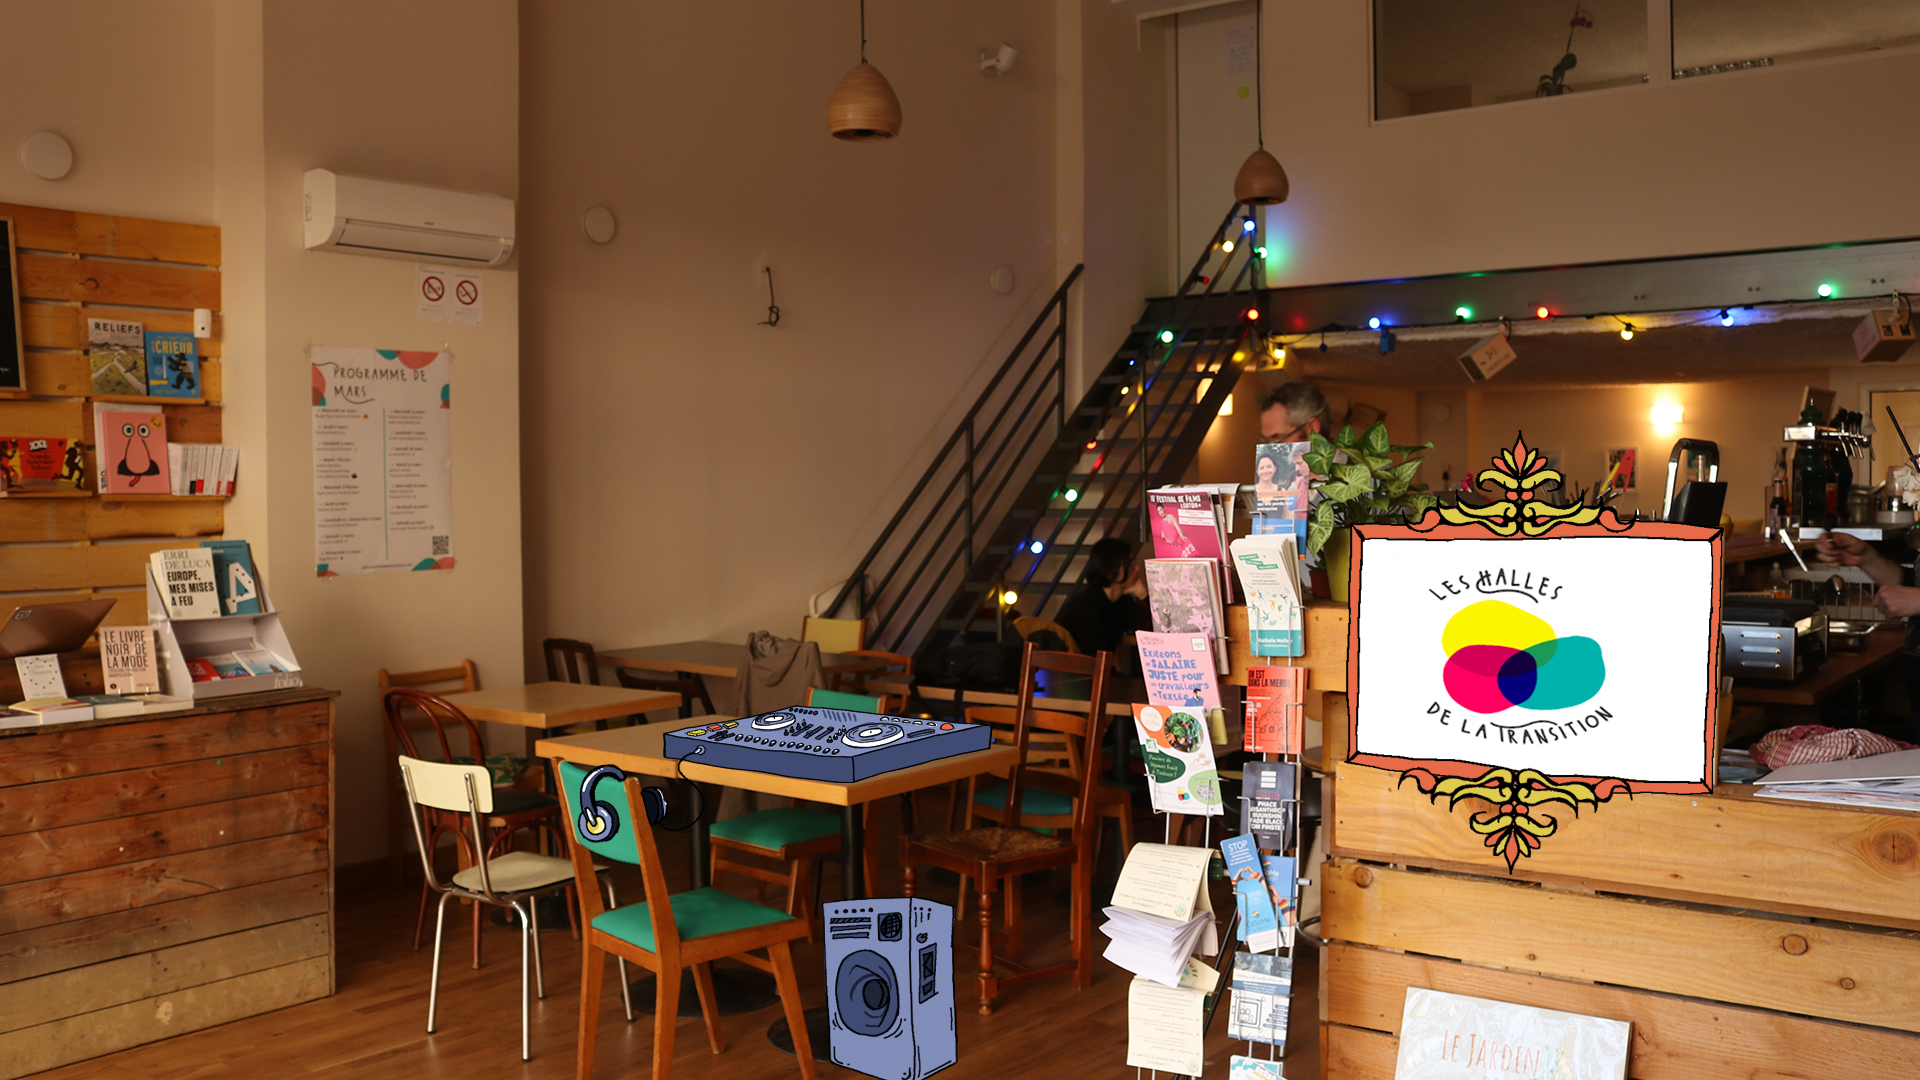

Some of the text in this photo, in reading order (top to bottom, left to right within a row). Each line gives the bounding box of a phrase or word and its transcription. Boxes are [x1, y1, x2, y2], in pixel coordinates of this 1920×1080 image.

[95, 322, 140, 334] RELIEFS
[155, 341, 193, 354] CRIEUR
[334, 367, 427, 382] PROGRAMME DE
[334, 385, 371, 400] MARS
[163, 551, 188, 560] ERRI
[165, 560, 212, 570] DE LUCA
[167, 570, 201, 582] EUROPE,
[169, 582, 214, 594] MES MISES
[179, 596, 193, 606] FEU
[104, 630, 146, 643] LE LIVRE
[106, 643, 148, 656] NOIR DE
[107, 655, 148, 669] LA MODE
[1151, 659, 1197, 669] SALAIRE
[274, 672, 300, 690] folio
[1148, 669, 1178, 681] JUSTE
[1262, 679, 1268, 687] LA
[1270, 679, 1291, 687] MERDE
[1157, 691, 1188, 700] Textile
[1228, 840, 1248, 852] STOP
[1442, 1030, 1540, 1077] LE JARDIN
